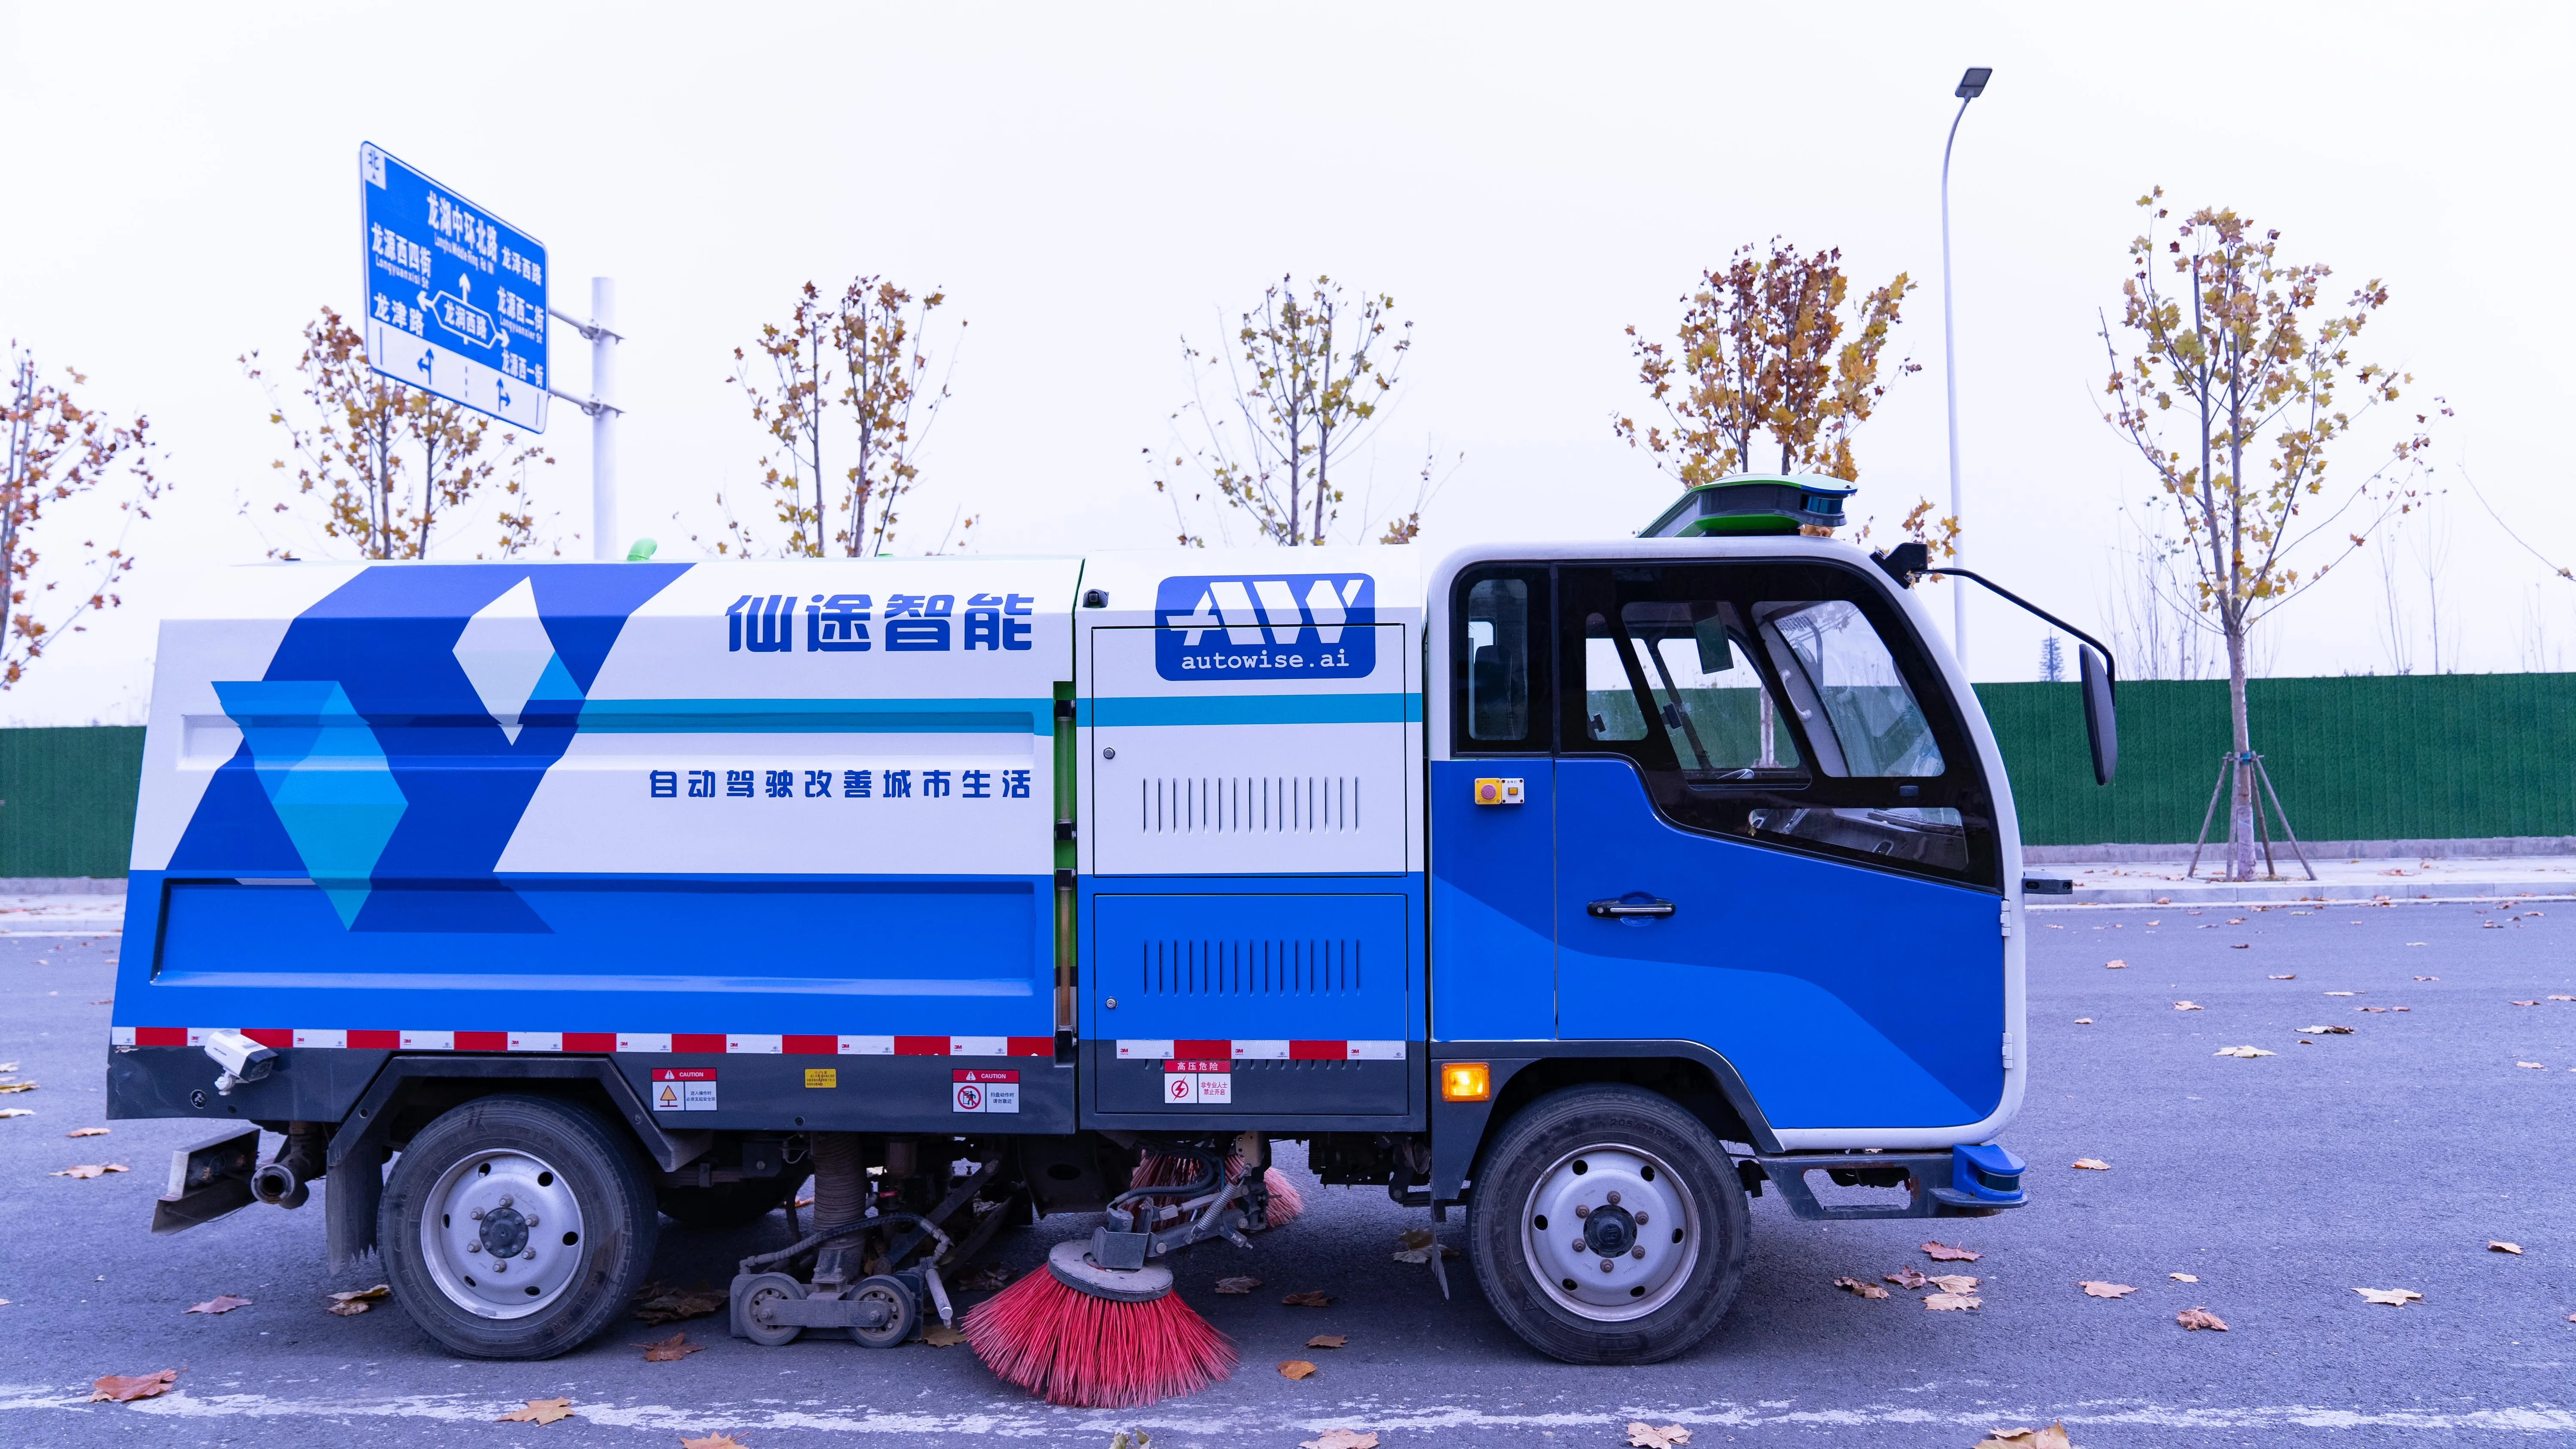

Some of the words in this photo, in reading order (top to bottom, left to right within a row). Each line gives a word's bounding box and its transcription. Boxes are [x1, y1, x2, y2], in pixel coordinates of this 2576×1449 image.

[368, 149, 379, 170] 北
[426, 190, 497, 263] 龙湖中环北路
[371, 221, 431, 278] 龙源西四街
[501, 246, 542, 287] 龙泽西路
[374, 292, 424, 337] 龙津路
[444, 300, 487, 340] 龙润西路
[497, 285, 544, 333] 龙源西二街
[501, 348, 543, 388] 龙源西一街
[725, 593, 1034, 652] 仙途智能
[1182, 649, 1349, 669] autowise.ai
[650, 770, 1031, 798] 自动驾驶改善城市生活
[1177, 1062, 1218, 1070] 高压危险
